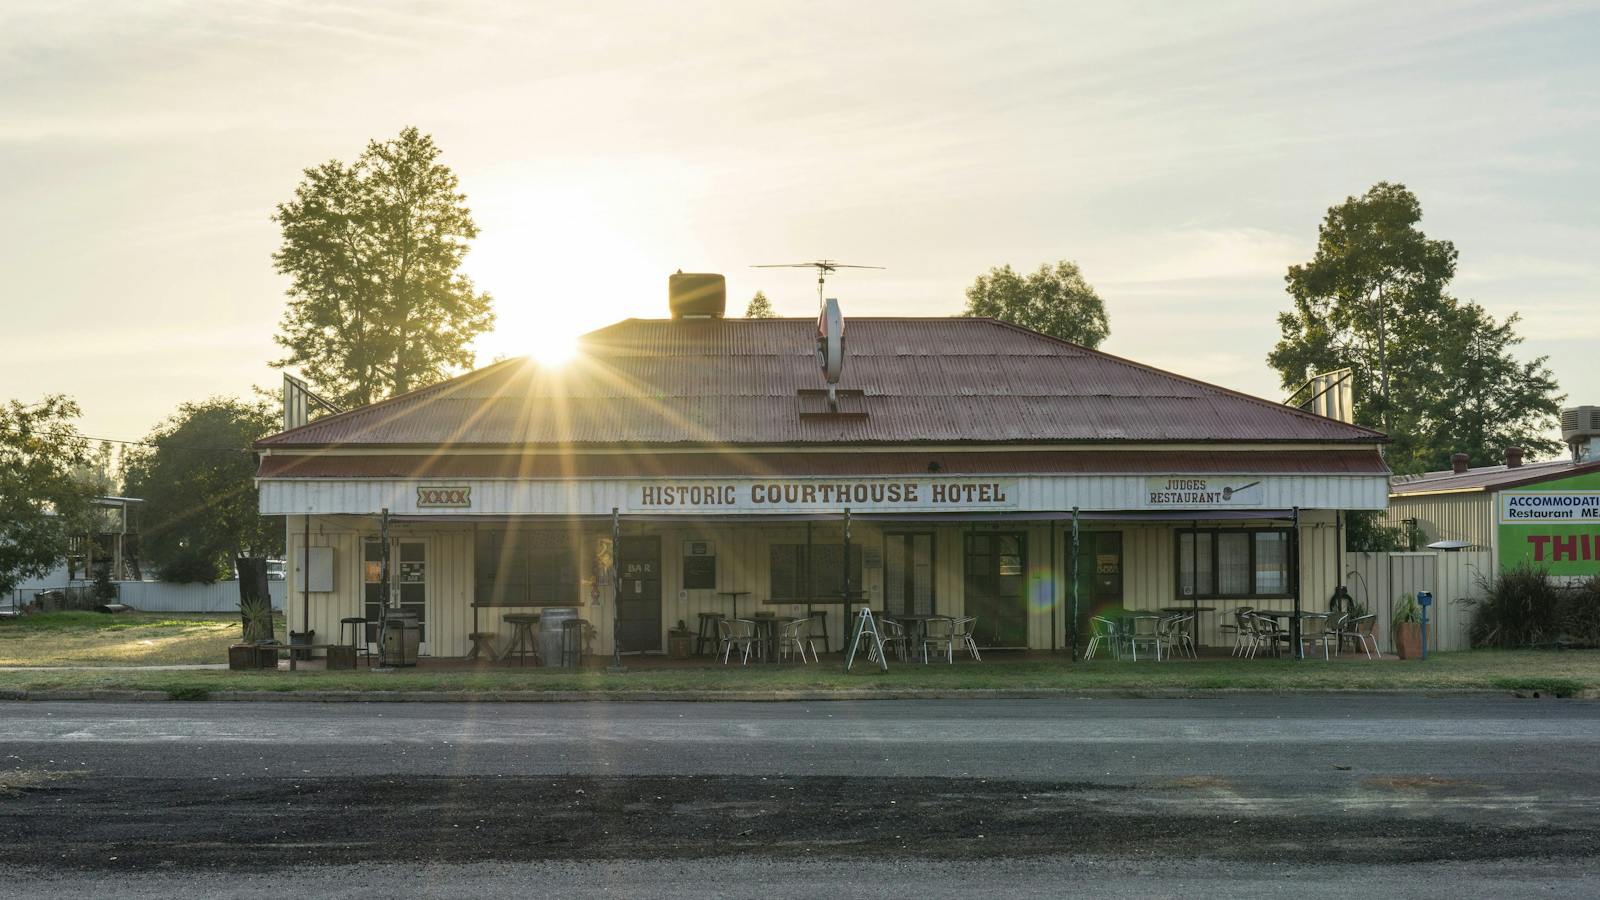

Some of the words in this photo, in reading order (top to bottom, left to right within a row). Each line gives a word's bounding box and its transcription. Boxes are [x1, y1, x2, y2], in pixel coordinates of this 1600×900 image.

[1165, 480, 1206, 490] JUDGES
[421, 490, 466, 504] XXXX
[642, 486, 736, 505] HISTORIC
[751, 484, 918, 503] COURTHOUSE
[932, 483, 1006, 503] HOTEL
[1150, 492, 1221, 503] RESTAURANT
[1509, 497, 1599, 506] ACCOMMODATI
[1509, 508, 1573, 518] Restaurant
[1581, 508, 1600, 518] ME
